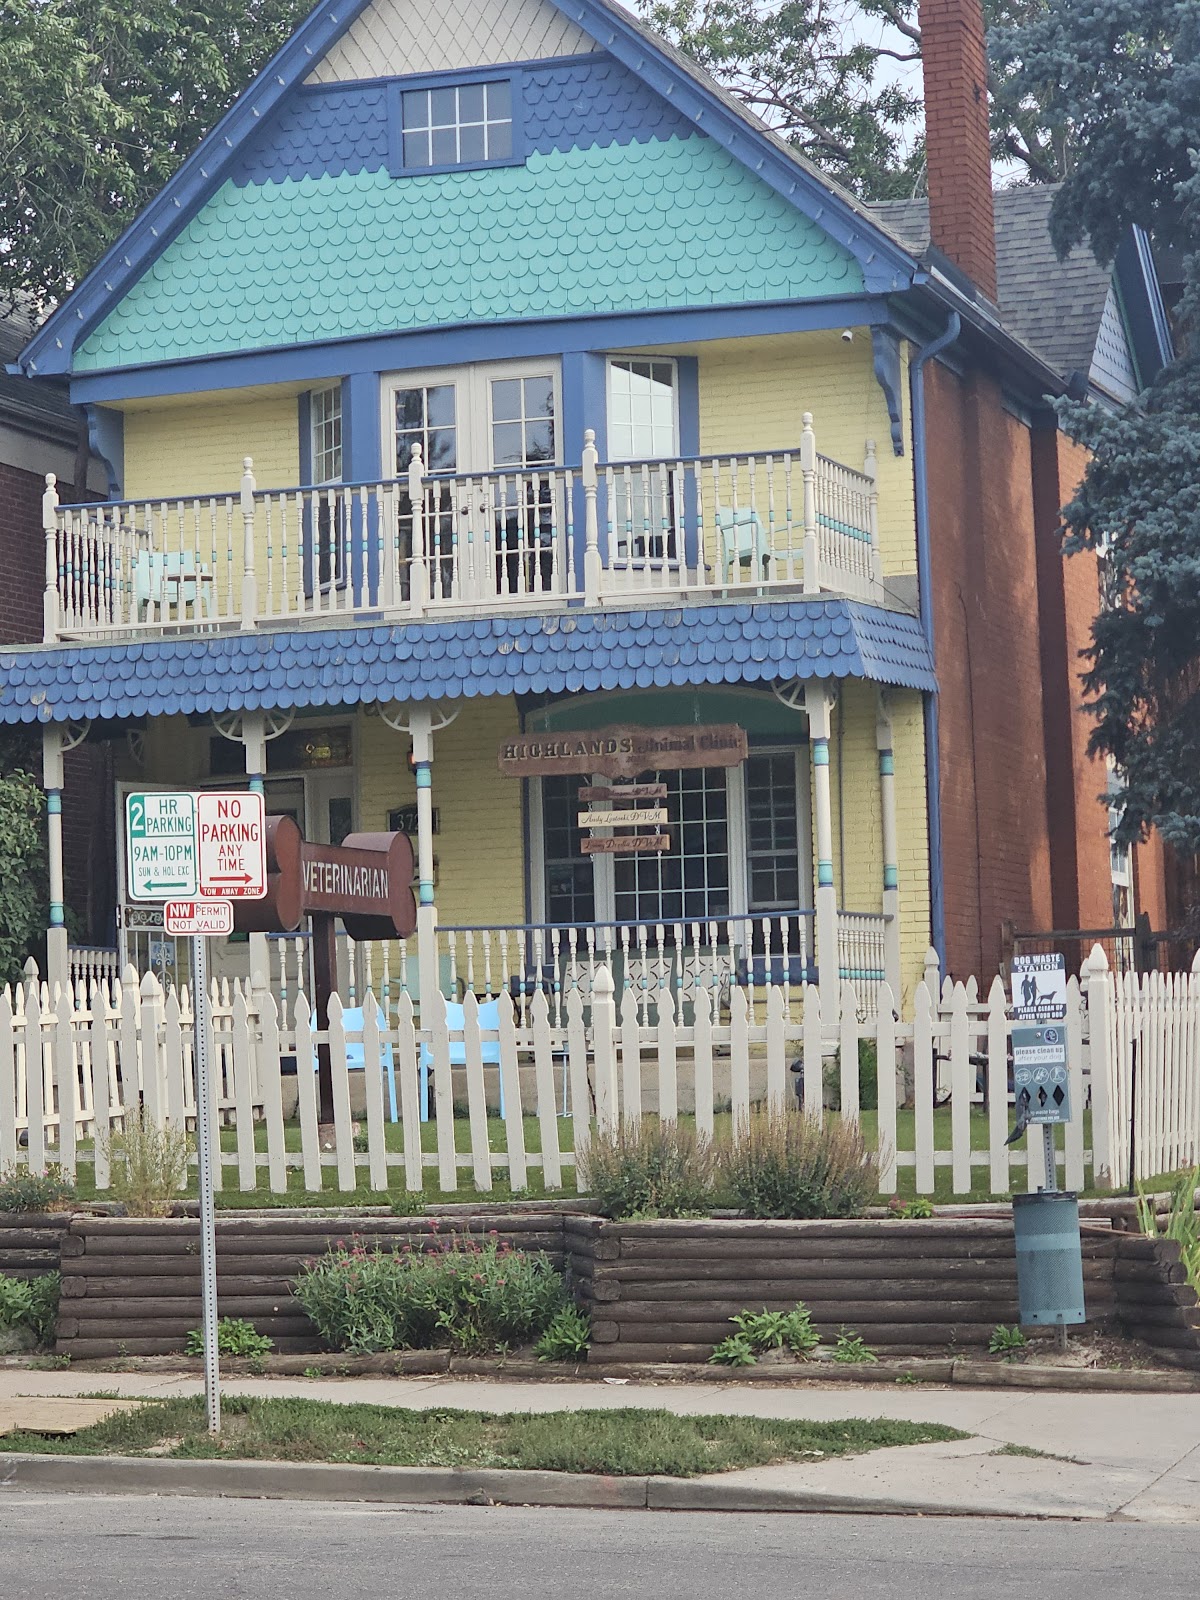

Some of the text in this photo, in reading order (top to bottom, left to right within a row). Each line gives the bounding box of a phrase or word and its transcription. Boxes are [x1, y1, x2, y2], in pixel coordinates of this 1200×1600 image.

[503, 737, 633, 761] HIGHLANDS
[159, 800, 178, 815] HR
[217, 800, 241, 818] NO
[131, 802, 144, 831] 2
[147, 816, 192, 833] PARKING
[202, 823, 258, 842] PARKING
[134, 845, 192, 861] 9AM-10PM
[218, 844, 243, 857] ANY
[138, 865, 190, 877] SUN & HOL EXC
[217, 859, 245, 871] TIME
[302, 860, 389, 899] VETERINARIAN
[203, 888, 217, 896] TOW
[243, 887, 260, 895] ZONE
[169, 903, 227, 918] NW PERMIT
[172, 920, 226, 930] NOT VALID
[1014, 953, 1061, 965] DOG WASTE
[1017, 963, 1058, 973] STATION
[1015, 1048, 1036, 1056] please
[1055, 1047, 1064, 1055] up
[1049, 1053, 1062, 1061] dog
